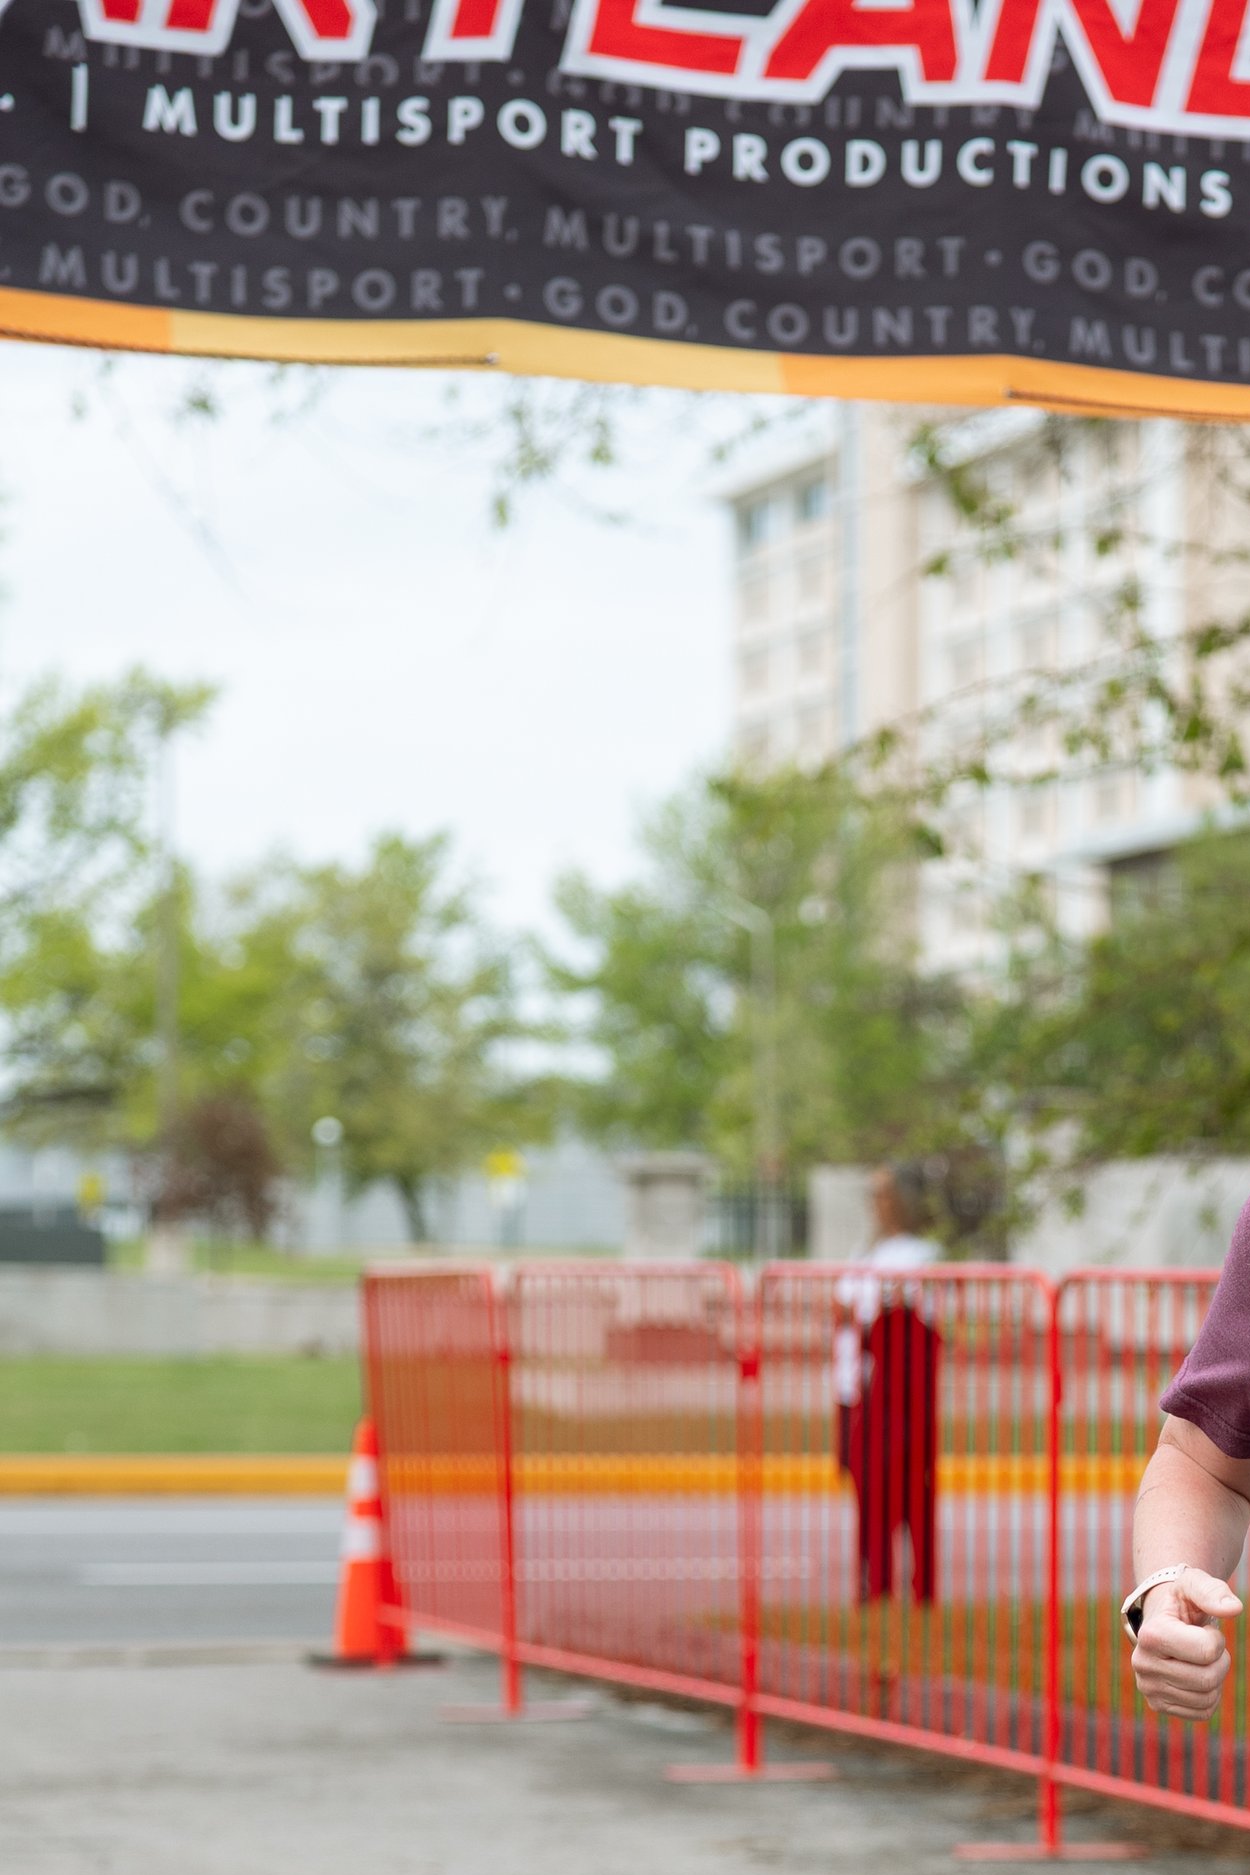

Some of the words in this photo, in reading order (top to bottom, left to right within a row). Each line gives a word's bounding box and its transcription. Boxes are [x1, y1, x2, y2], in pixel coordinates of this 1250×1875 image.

[142, 83, 644, 167] MULTISPORT
[683, 126, 1234, 219] PRODUCTIONS
[39, 241, 487, 311] MULTISPORT
[543, 205, 966, 280] MULTISPORT
